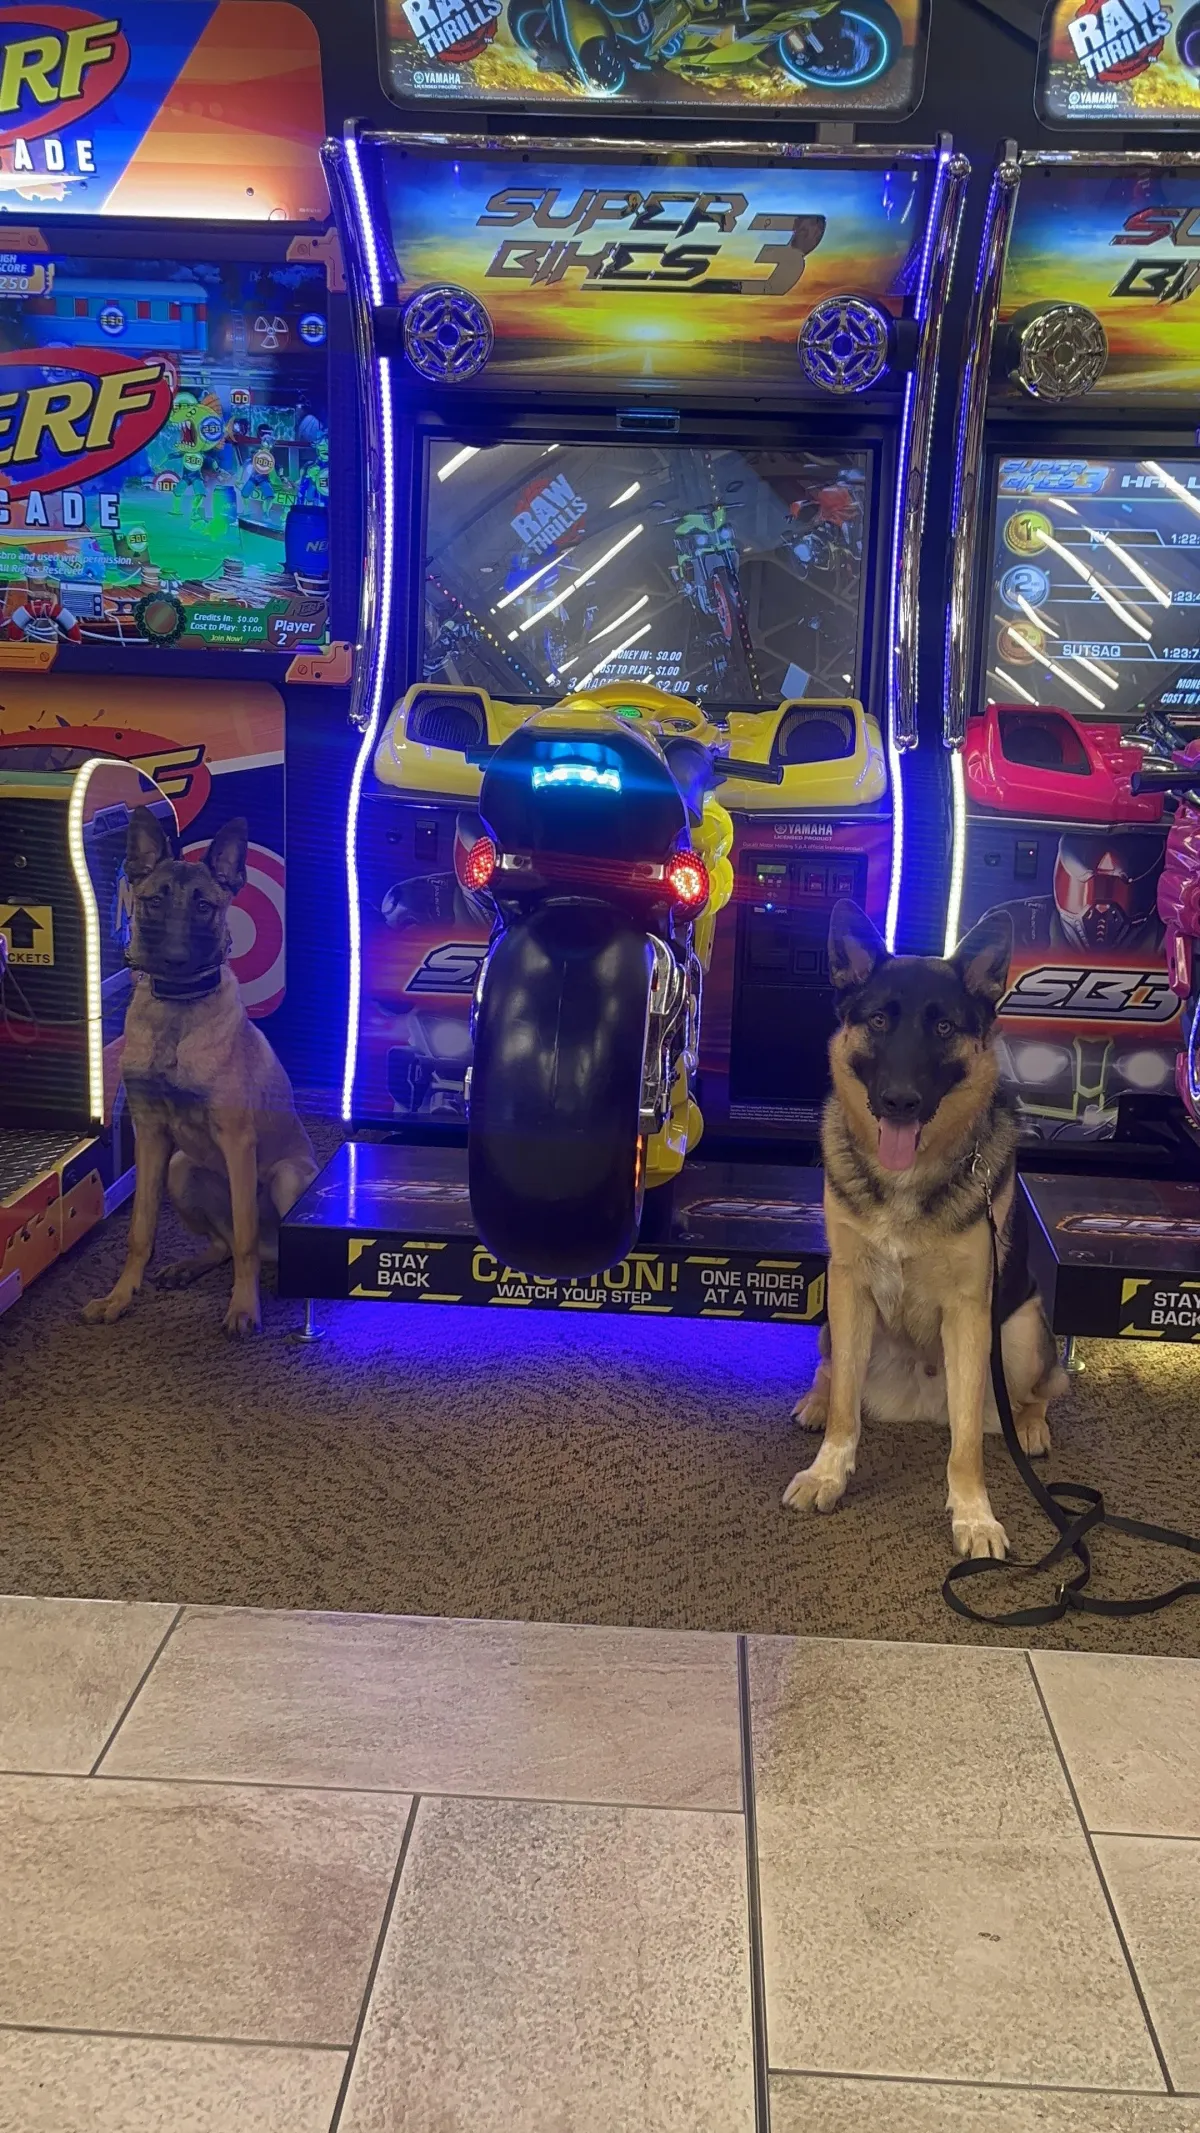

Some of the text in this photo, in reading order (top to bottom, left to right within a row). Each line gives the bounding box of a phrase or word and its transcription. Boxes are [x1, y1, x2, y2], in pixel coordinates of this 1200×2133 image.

[1080, 11, 1172, 79] THRILLS
[425, 73, 461, 84] YAMAHA
[1081, 92, 1118, 104] YAMAHA
[475, 187, 749, 238] SUPER
[485, 213, 827, 296] BIKES 3
[231, 394, 249, 405] 100
[510, 473, 575, 543] RAW
[528, 496, 588, 555] THRILLS
[18, 553, 35, 561] and
[37, 553, 59, 561] used
[83, 555, 133, 566] permission.
[12, 564, 40, 574] Rights
[193, 613, 259, 624] Credits In: $0.00
[190, 622, 263, 633] Cost to Play: $1.00
[274, 620, 316, 634] Player
[277, 633, 287, 645] 2
[612, 650, 682, 661] ONEY IN: $0.00
[1062, 644, 1121, 657] SUTSAQ
[598, 665, 680, 676] OST TO PLAY: $1.00
[1160, 693, 1184, 704] COST
[1184, 694, 1197, 704] TO
[789, 824, 833, 836] YAMAHA
[8, 953, 50, 963] CKETS
[379, 1253, 429, 1270] STAY
[472, 1253, 678, 1292] CAION!
[377, 1271, 430, 1288] BACK
[701, 1270, 804, 1290] ONE RIDER
[497, 1284, 652, 1304] WATCH YOUR STEP
[704, 1288, 730, 1304] AT
[733, 1289, 748, 1305] A
[752, 1290, 799, 1307] TIME
